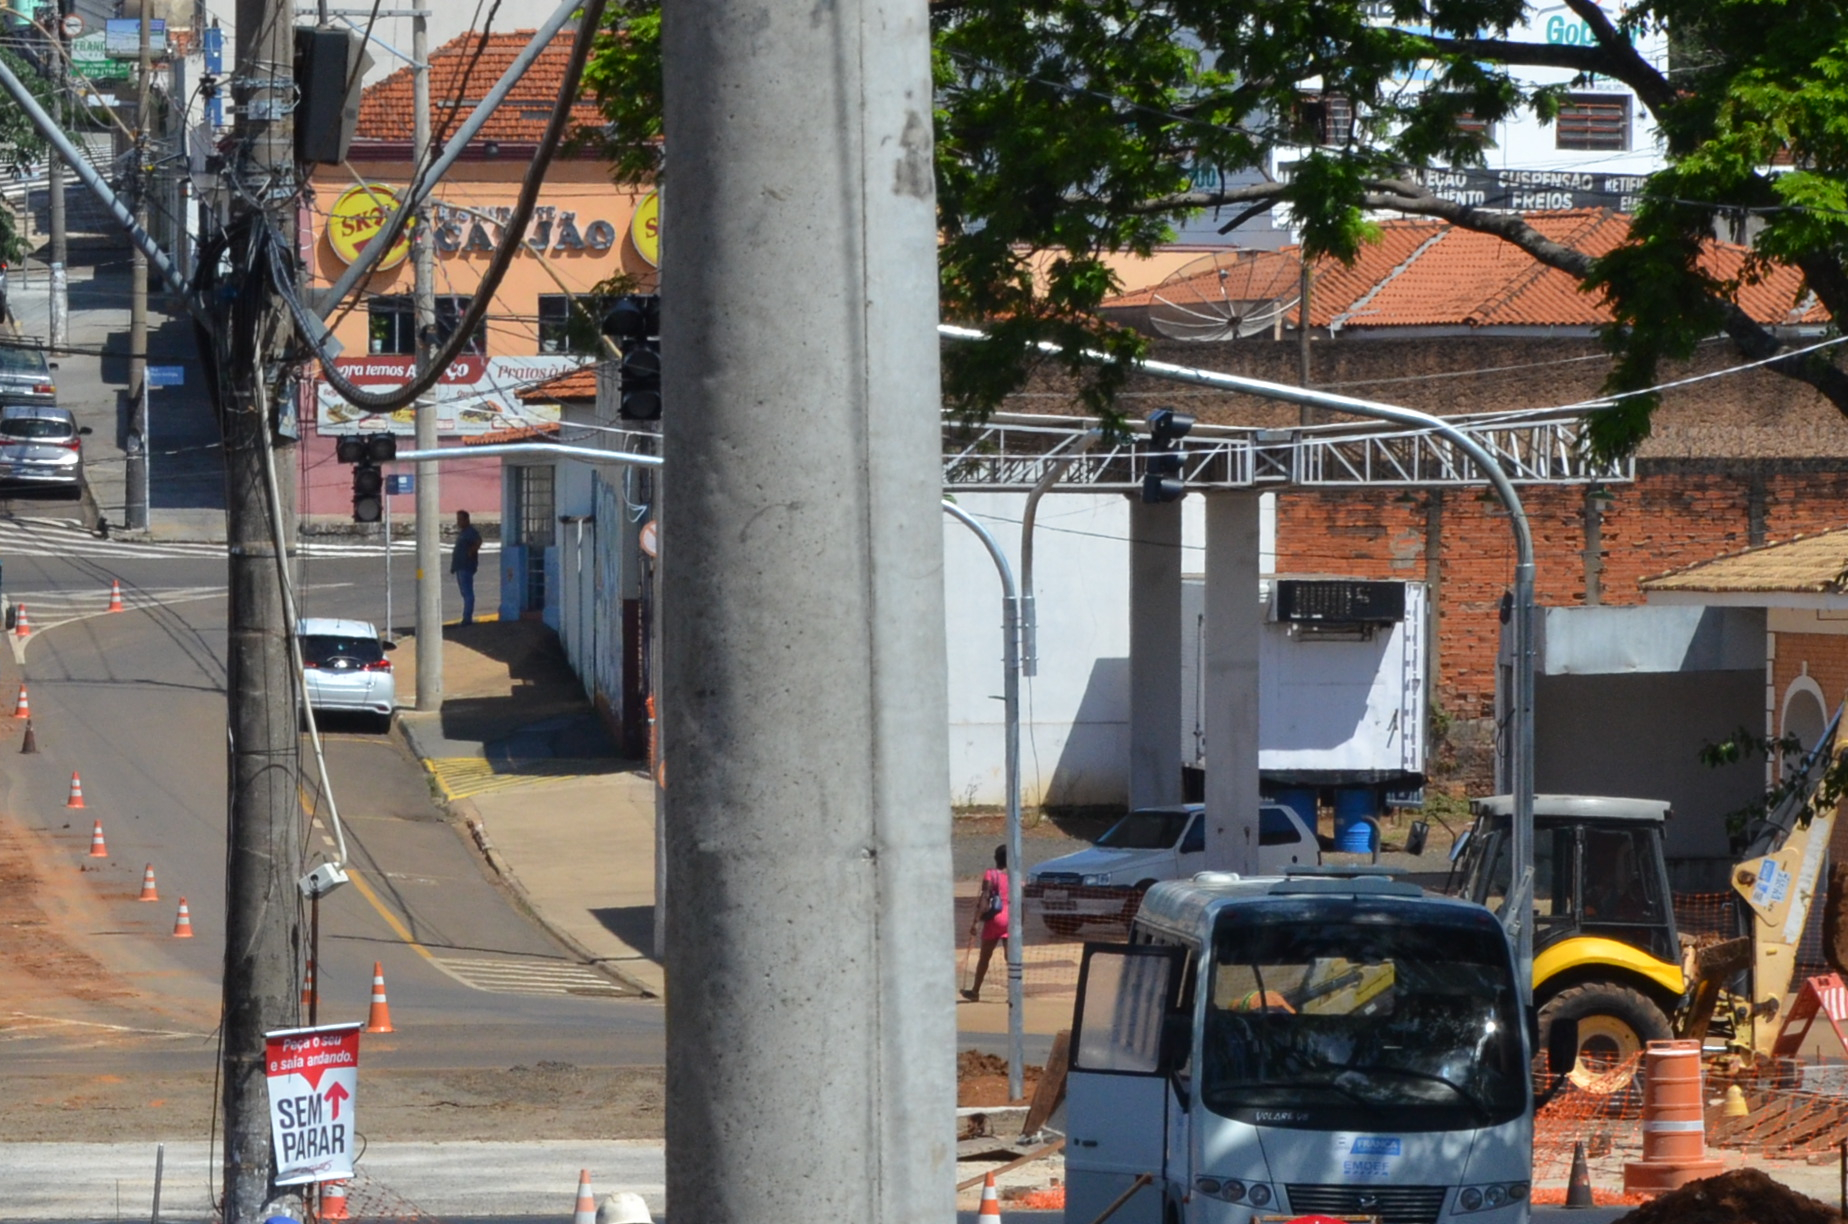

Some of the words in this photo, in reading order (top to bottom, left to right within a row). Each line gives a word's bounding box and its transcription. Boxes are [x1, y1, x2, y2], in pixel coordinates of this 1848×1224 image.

[1512, 192, 1573, 209] FREIOS
[342, 207, 385, 237] SKO
[365, 364, 404, 376] temos
[497, 364, 546, 379] Pratos
[283, 1038, 310, 1053] Peça
[313, 1037, 320, 1048] o
[321, 1036, 342, 1047] seu
[270, 1062, 278, 1072] e
[280, 1057, 304, 1071] saia
[307, 1050, 354, 1066] andando.
[277, 1093, 322, 1130] SEM
[1256, 1111, 1294, 1121] VOLARE
[282, 1124, 345, 1163] PARAR
[1357, 1139, 1398, 1149] FRANCA
[1343, 1161, 1390, 1171] EMDEF
